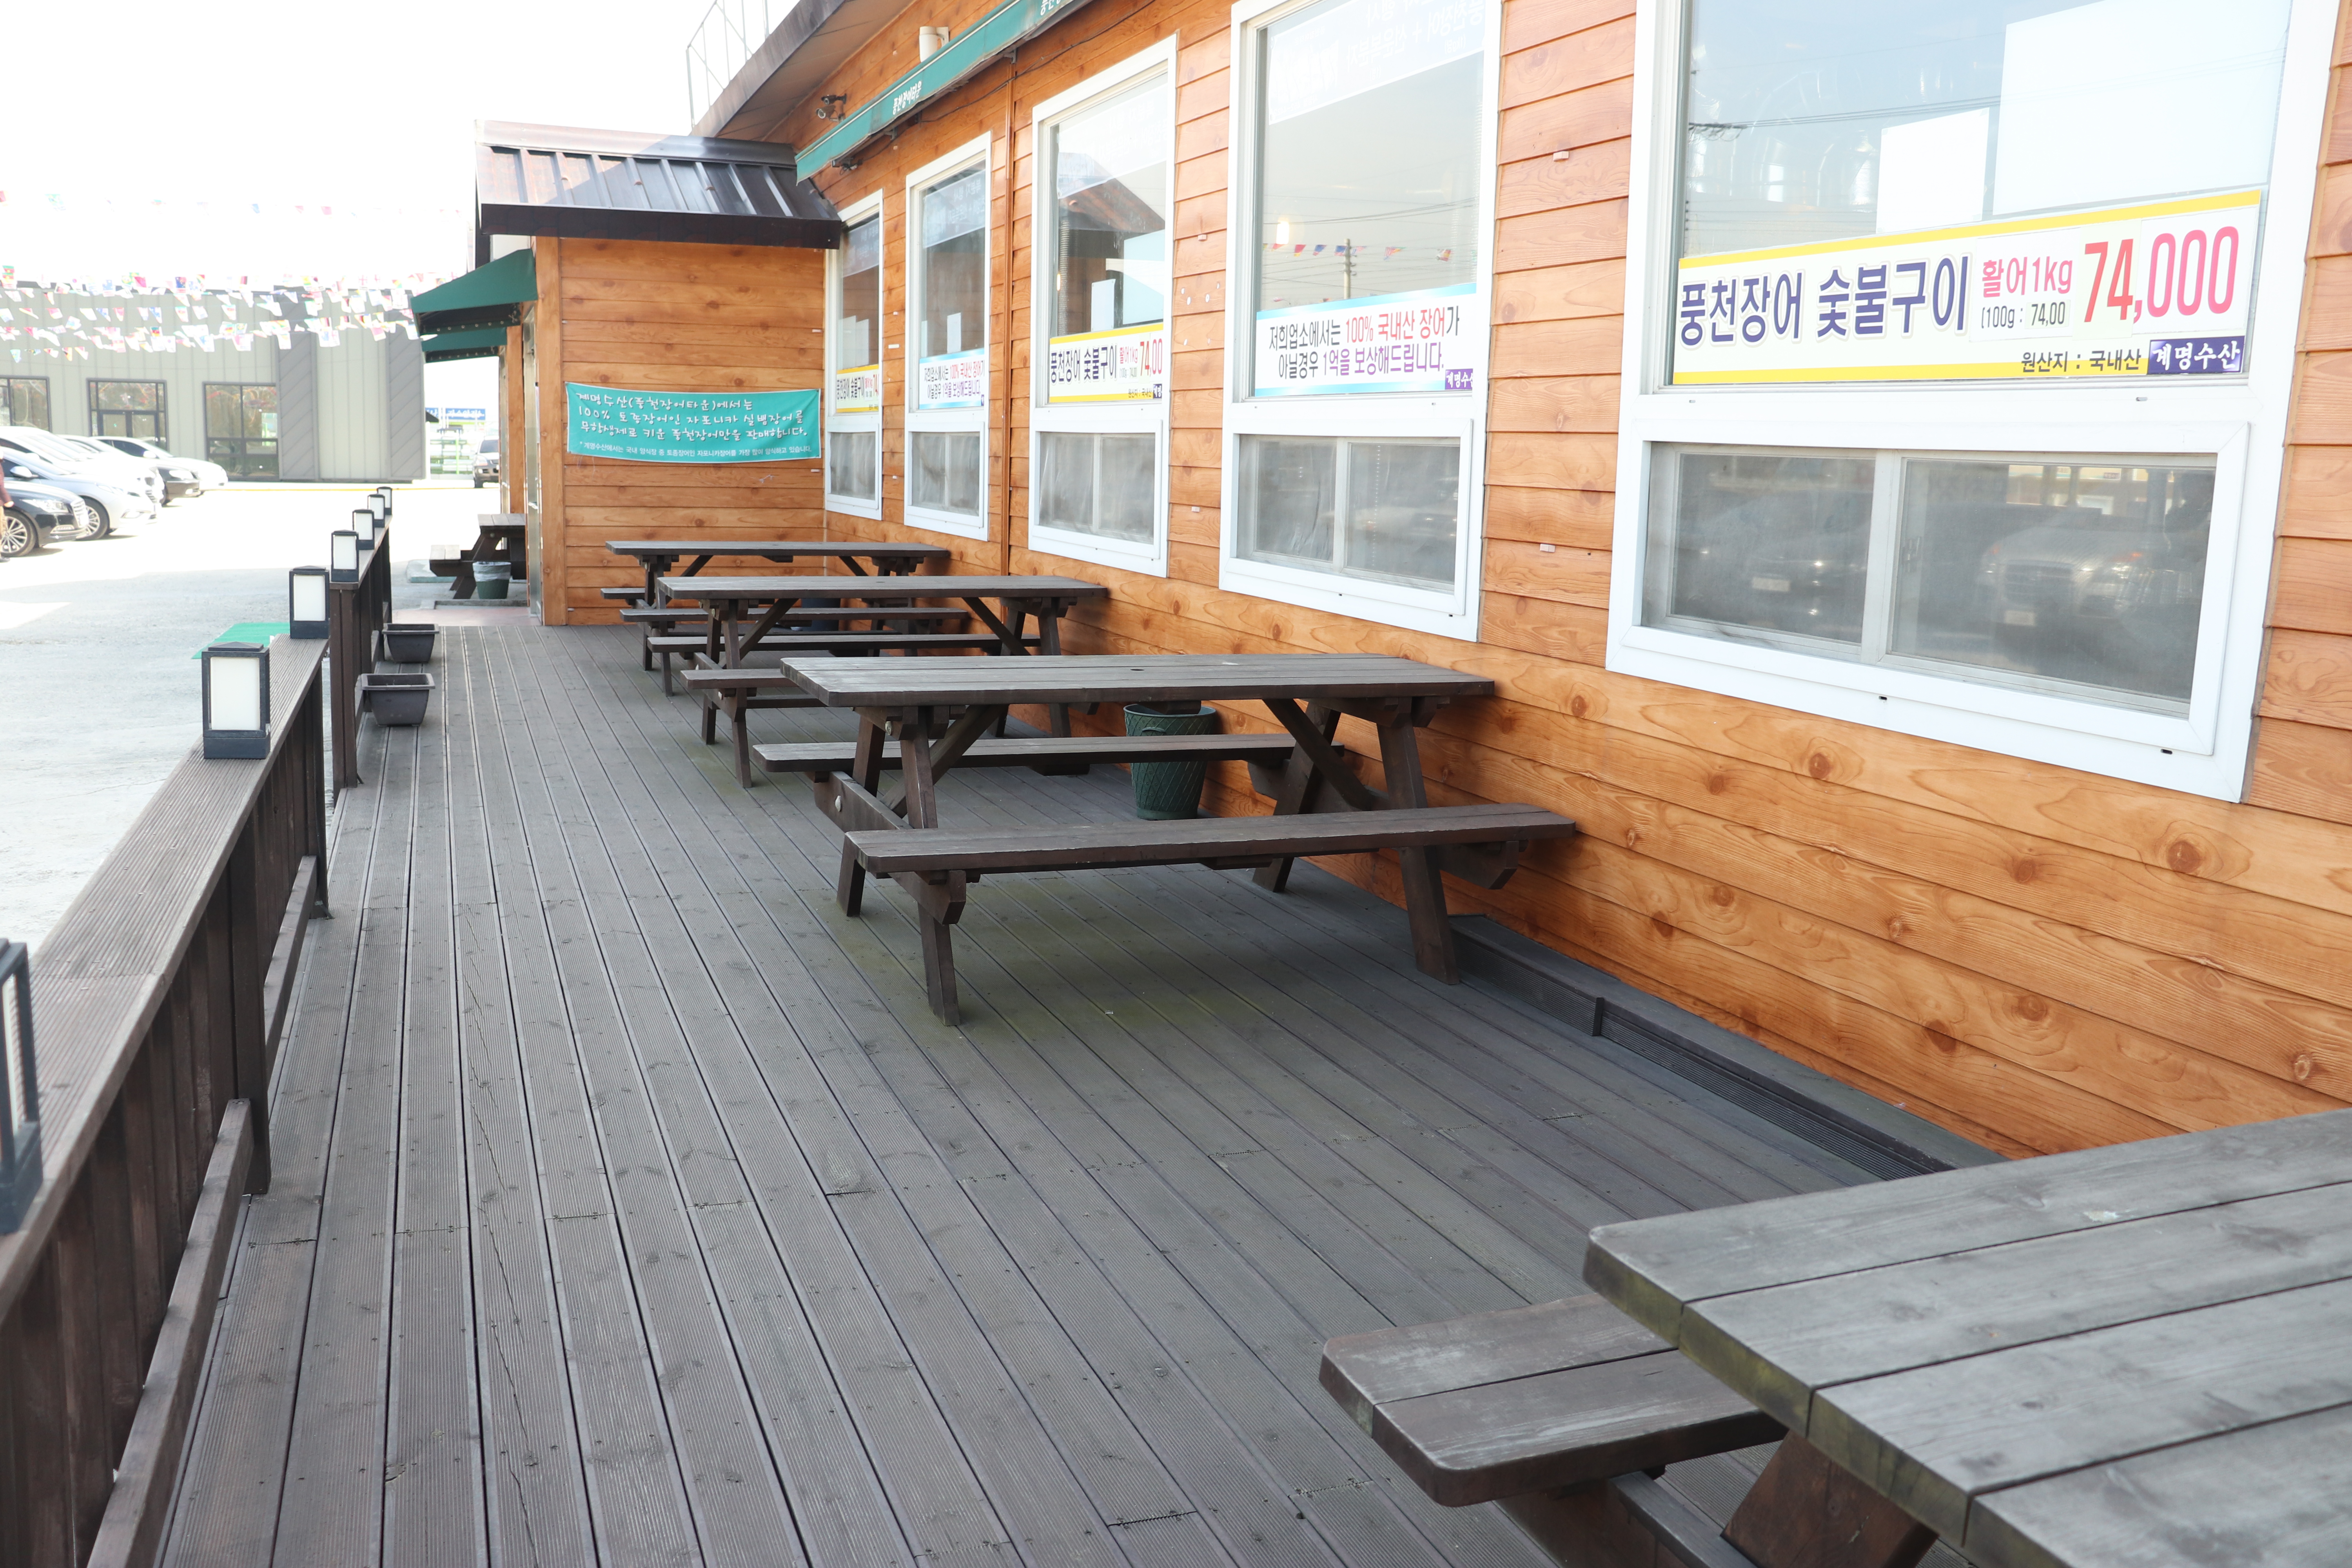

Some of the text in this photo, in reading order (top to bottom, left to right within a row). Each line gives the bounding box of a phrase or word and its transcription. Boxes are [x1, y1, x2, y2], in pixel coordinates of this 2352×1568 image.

[893, 81, 922, 115] 풍천장어타운
[1982, 256, 2073, 298] 활어1kg
[2084, 226, 2239, 324] 74,000
[1680, 256, 1969, 346] 풍천장어 숯불구이
[1269, 305, 1460, 351] 저희업소에서는 100% 국내산 장어가
[1050, 345, 1117, 384] 풍천장어 숯불구이
[1119, 346, 1138, 364] 활어1kg
[1279, 341, 1444, 379] 아닐경우 1억을 보상해드립니다.
[2021, 350, 2068, 372] 원산지
[2089, 348, 2141, 371] 국내산
[2151, 340, 2241, 371] 계명수산
[1128, 388, 1138, 398] 원산지
[1142, 388, 1152, 397] 국내산
[579, 405, 804, 426] 100% 토종장어인 자포니카 실뱀장어를
[581, 420, 808, 441] 무항생제로 키운 풍천장어만을 판매합니다.
[584, 442, 624, 453] 계명수산에서는
[625, 446, 637, 454] 국내
[639, 448, 657, 456] 양식장
